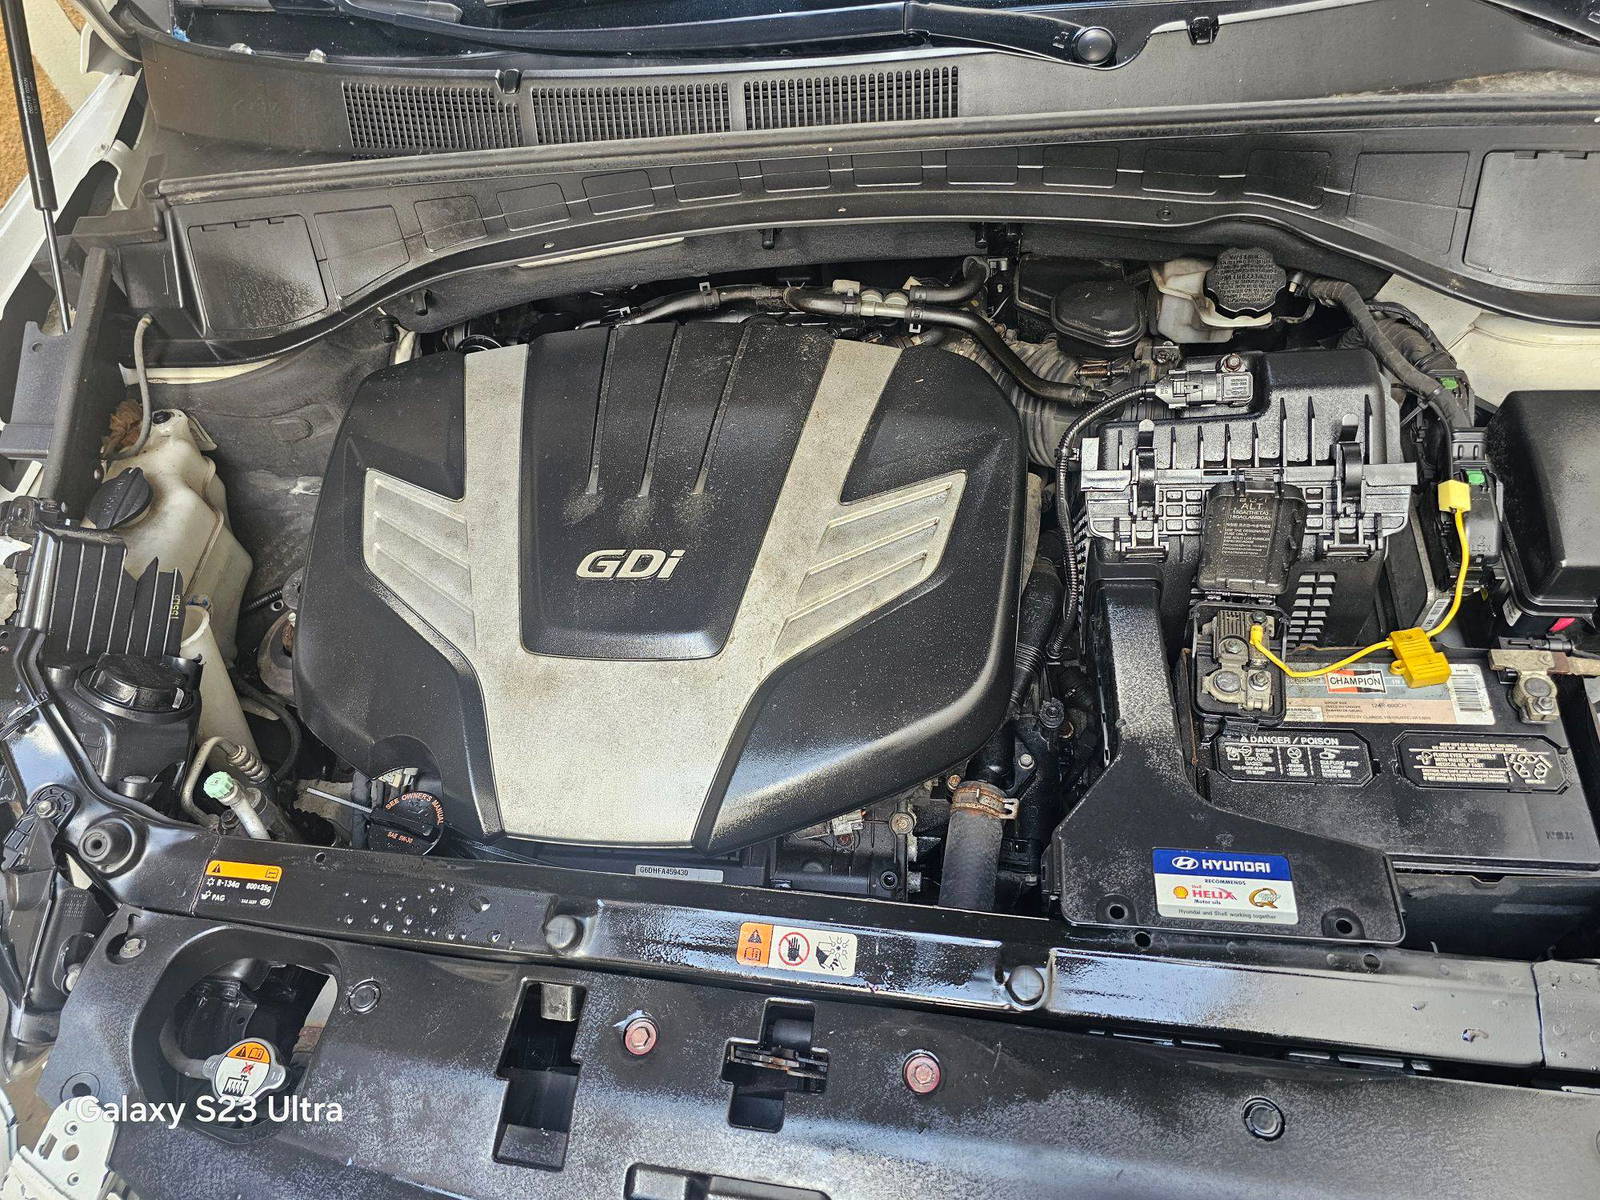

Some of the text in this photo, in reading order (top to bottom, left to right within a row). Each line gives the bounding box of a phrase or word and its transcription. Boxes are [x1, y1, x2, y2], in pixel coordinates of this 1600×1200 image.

[576, 549, 686, 579] GDi
[1330, 675, 1381, 687] CHAMPION
[1250, 736, 1290, 744] DANGER
[1301, 737, 1339, 745] POISON
[401, 792, 433, 802] OWNER'S
[1202, 859, 1271, 873] HYUNDAI
[211, 893, 226, 902] PAG
[1192, 889, 1236, 900] HELIX
